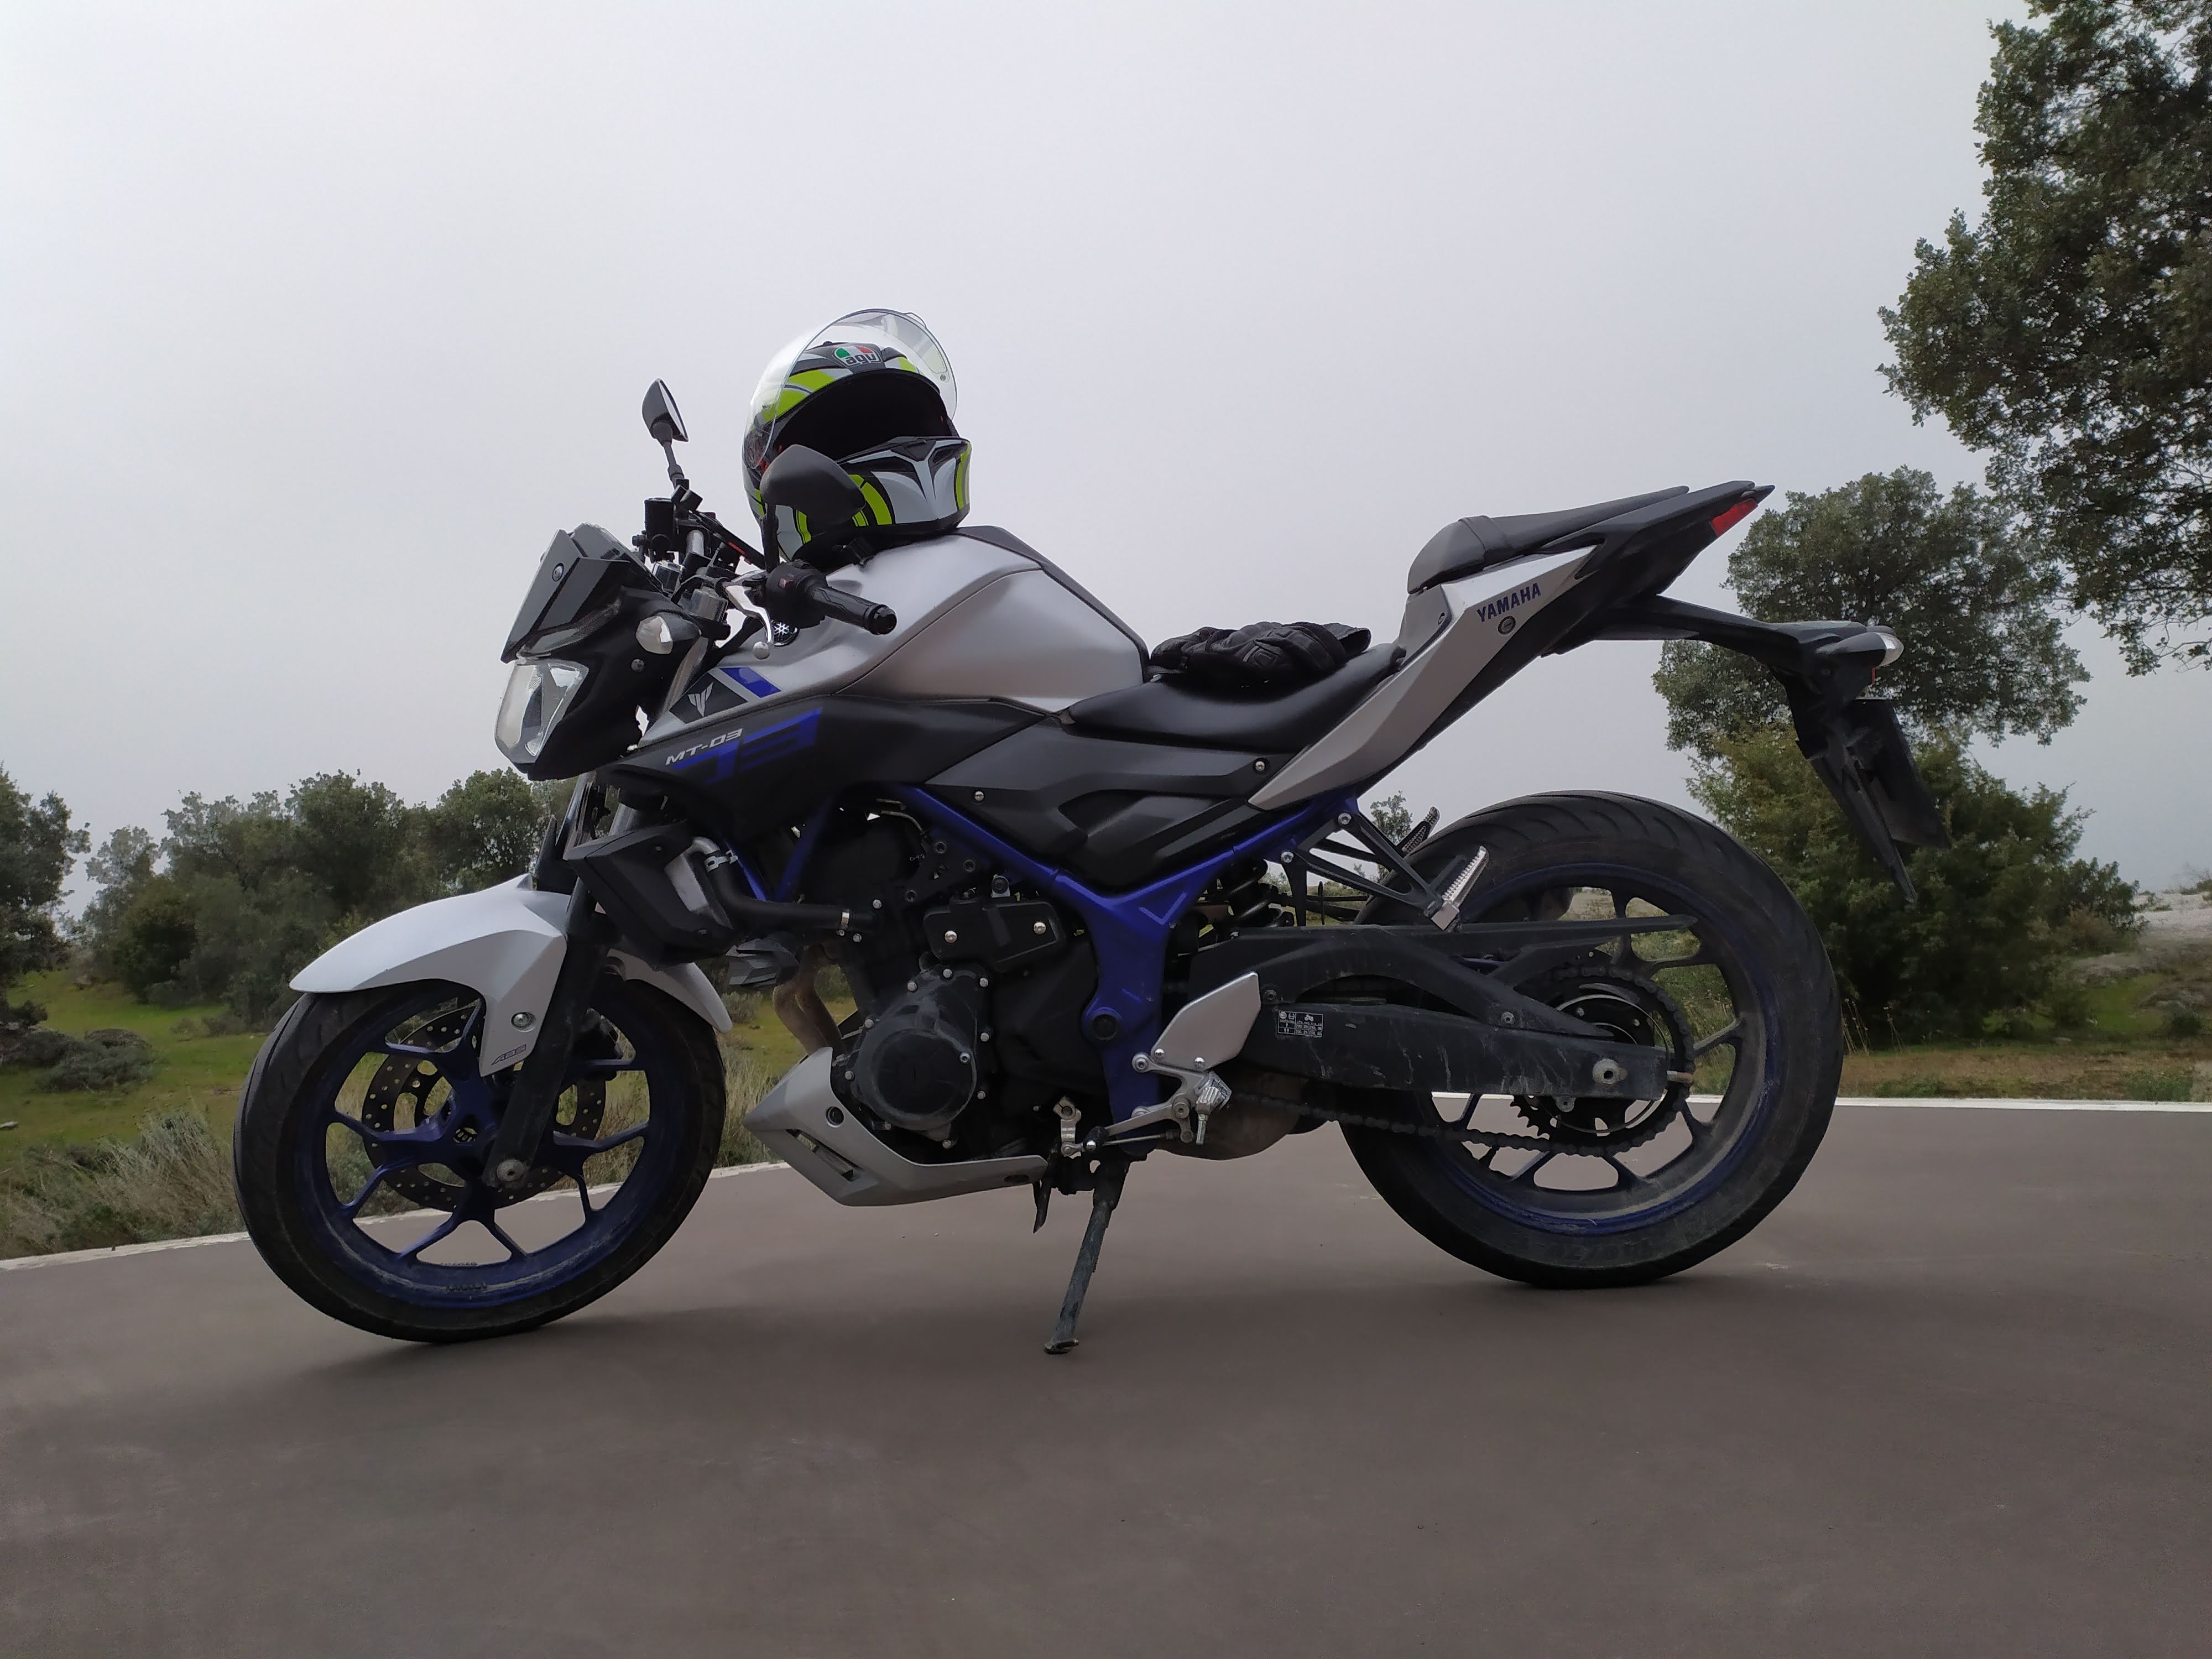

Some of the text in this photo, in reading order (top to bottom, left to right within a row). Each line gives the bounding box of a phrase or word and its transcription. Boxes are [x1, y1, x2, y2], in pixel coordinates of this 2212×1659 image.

[1477, 582, 1542, 623] YAMAHA
[665, 727, 743, 766] MT-03
[491, 1044, 526, 1066] ABS
